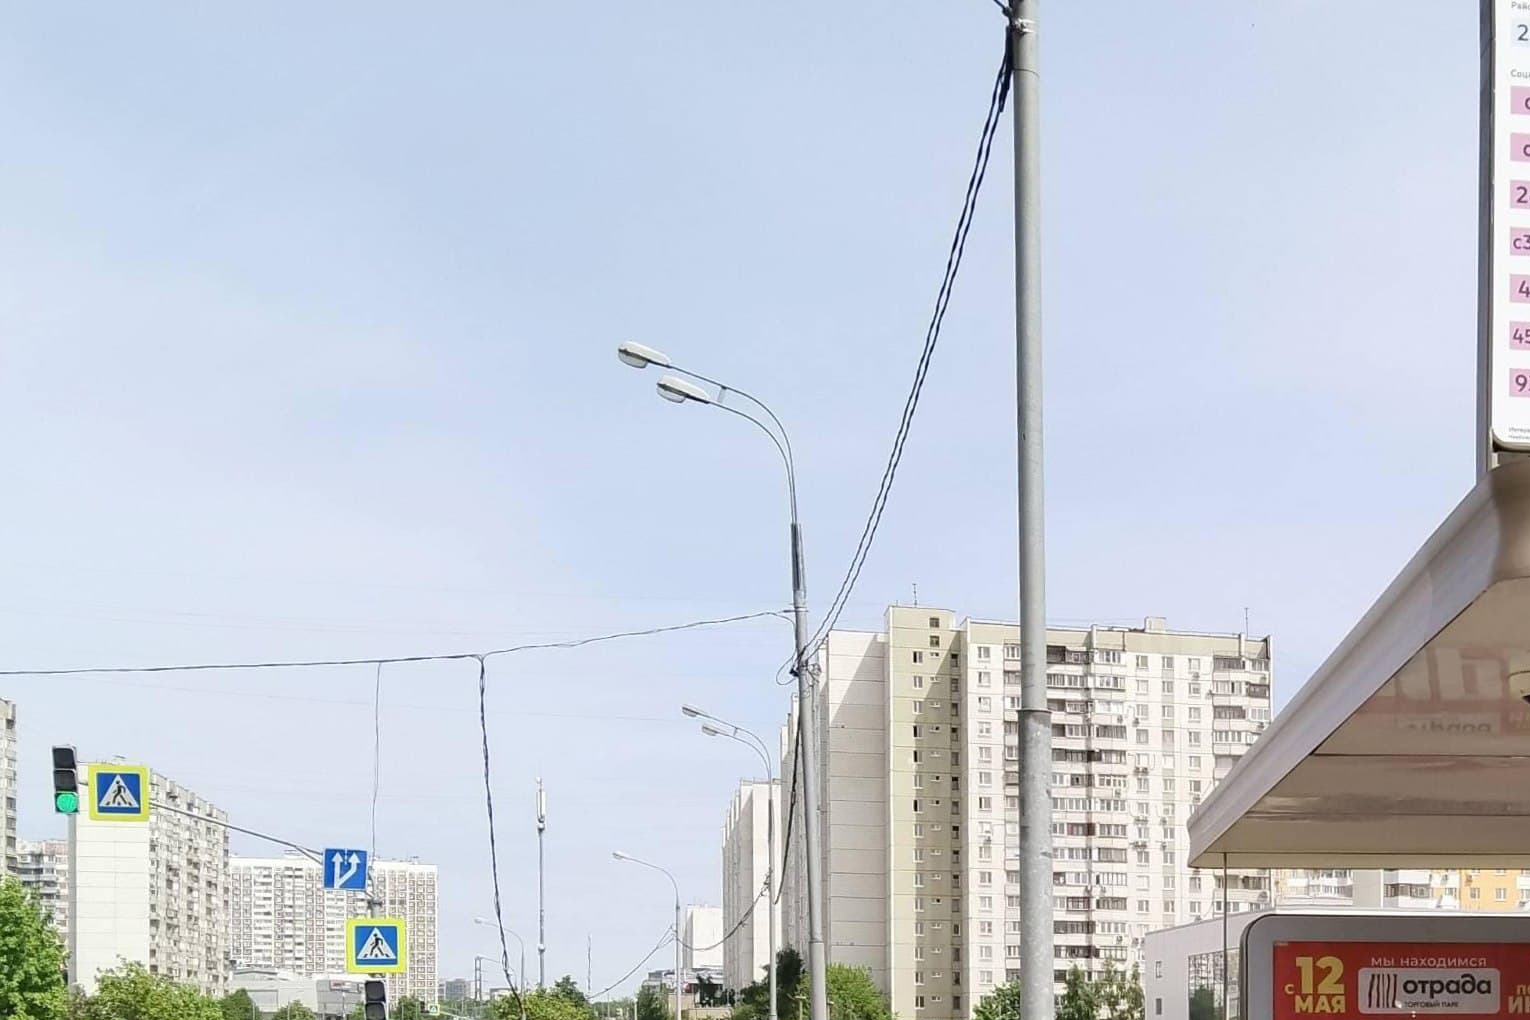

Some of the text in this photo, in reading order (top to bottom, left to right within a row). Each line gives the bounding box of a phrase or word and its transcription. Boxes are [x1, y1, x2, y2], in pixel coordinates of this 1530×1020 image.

[1371, 958, 1487, 967] мы находимся
[1284, 956, 1344, 995] с 12
[1403, 973, 1491, 999] отрада
[1295, 996, 1345, 1014] МАЯ
